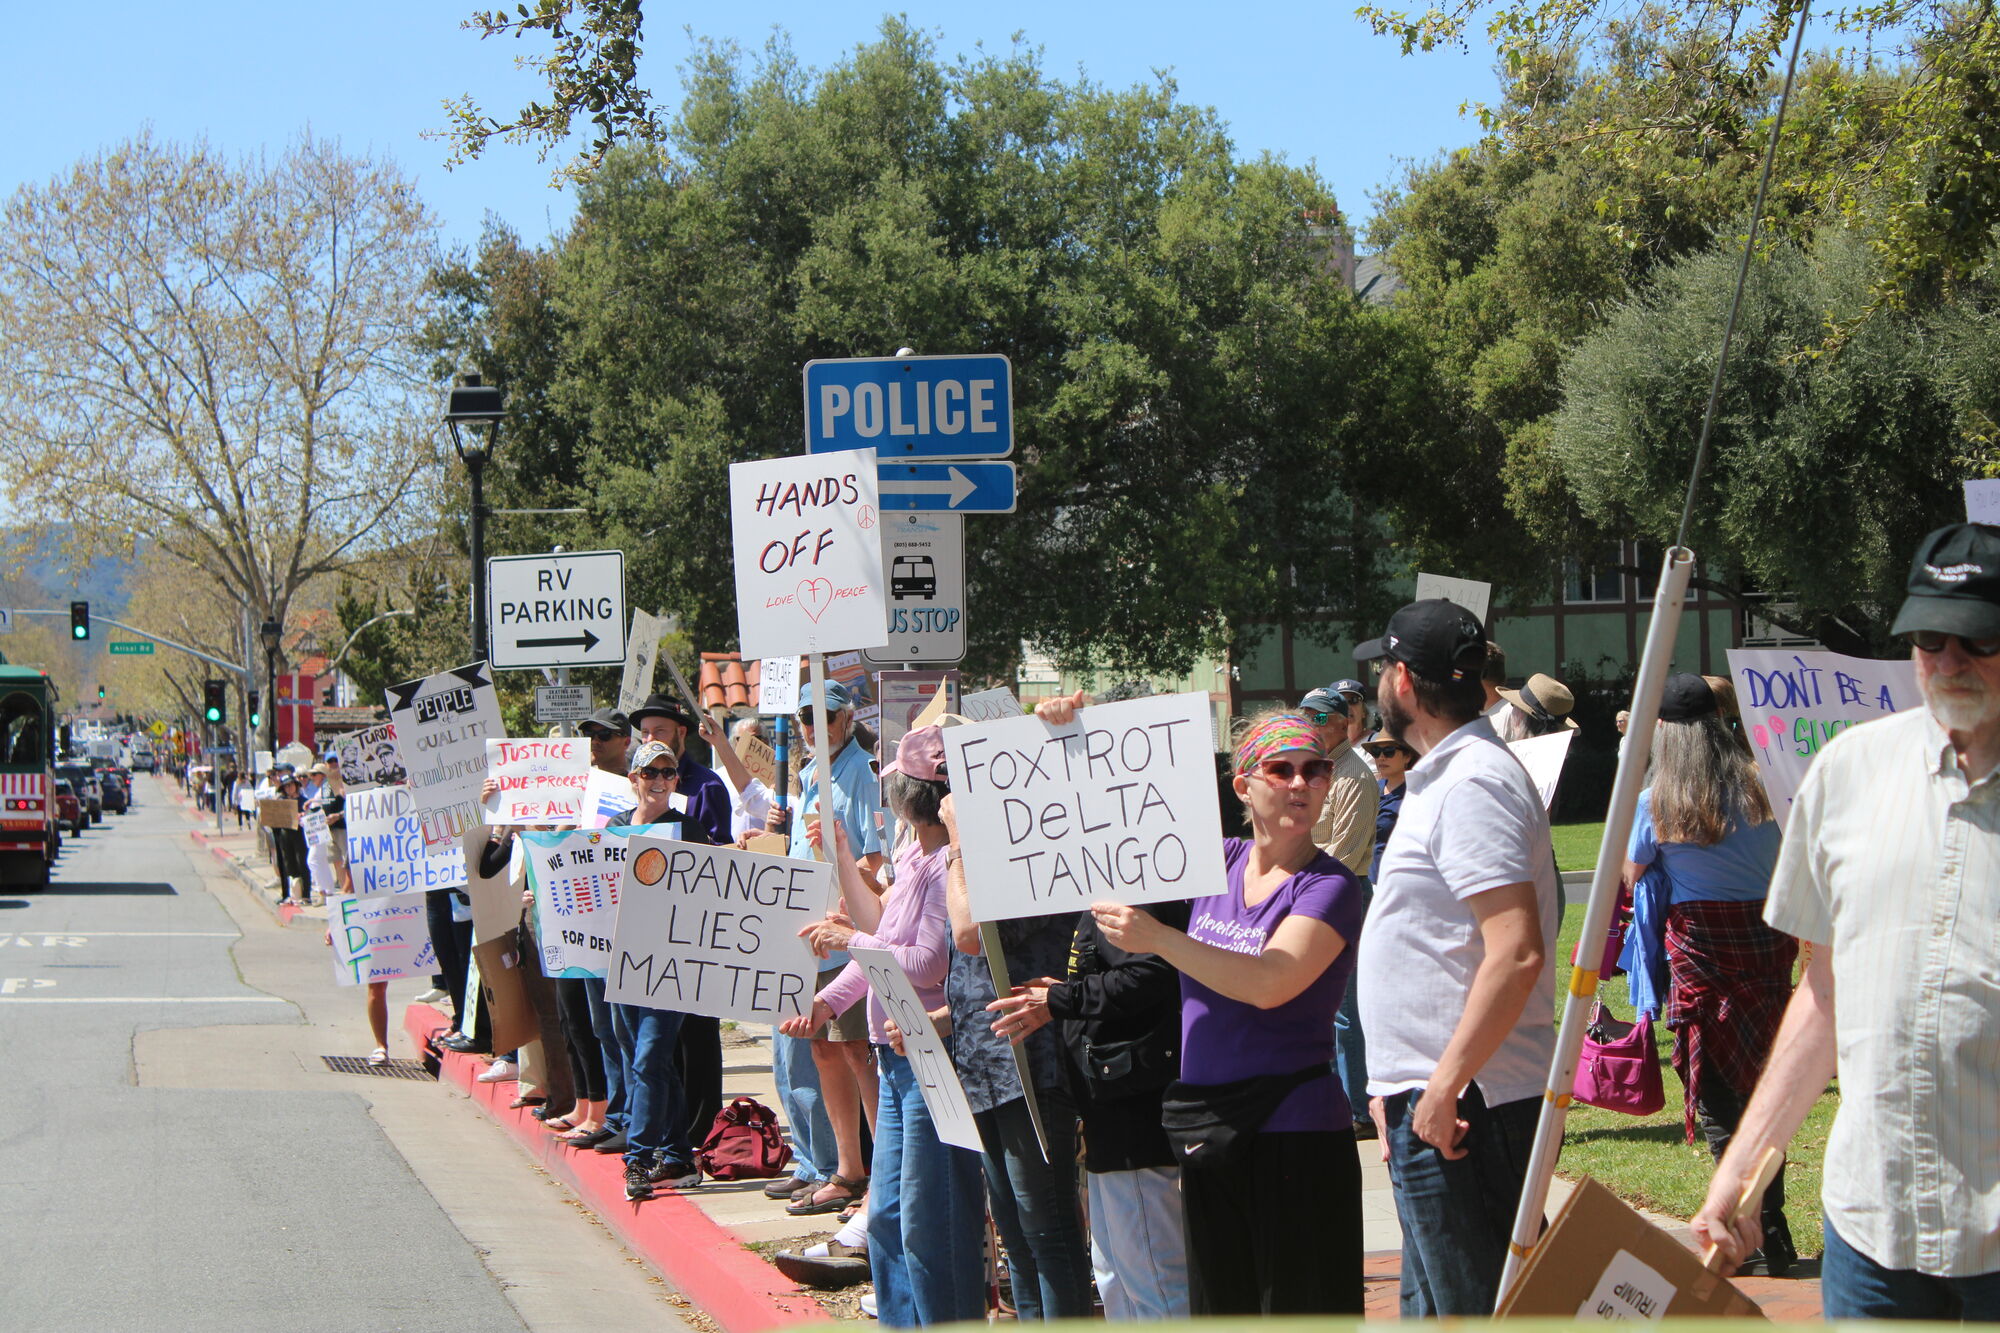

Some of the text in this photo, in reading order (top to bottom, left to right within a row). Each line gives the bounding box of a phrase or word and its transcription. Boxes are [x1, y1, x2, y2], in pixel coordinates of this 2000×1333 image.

[821, 379, 997, 438] POLICE
[756, 474, 858, 517] HANDS
[760, 528, 834, 574] OFF
[538, 568, 572, 591] RV
[766, 585, 868, 608] LOVE PEACE
[501, 597, 613, 624] PARKING
[888, 607, 960, 633] US STOP
[1742, 656, 1896, 712] DON'T BE A
[415, 686, 473, 721] PEOPLE
[416, 720, 488, 752] QUALITY
[496, 743, 573, 766] JUSTICE
[961, 719, 1190, 793] FOXTROT
[511, 802, 540, 817] FOR
[364, 861, 468, 893] Neighbors
[547, 853, 564, 871] WE
[571, 849, 594, 864] THE
[1009, 833, 1187, 901] TANGO
[633, 847, 815, 911] ORANGE
[562, 930, 585, 947] FOR
[668, 904, 763, 954] LIES
[619, 951, 804, 1016] MATTER
[1613, 1282, 1658, 1319] TRUMP
